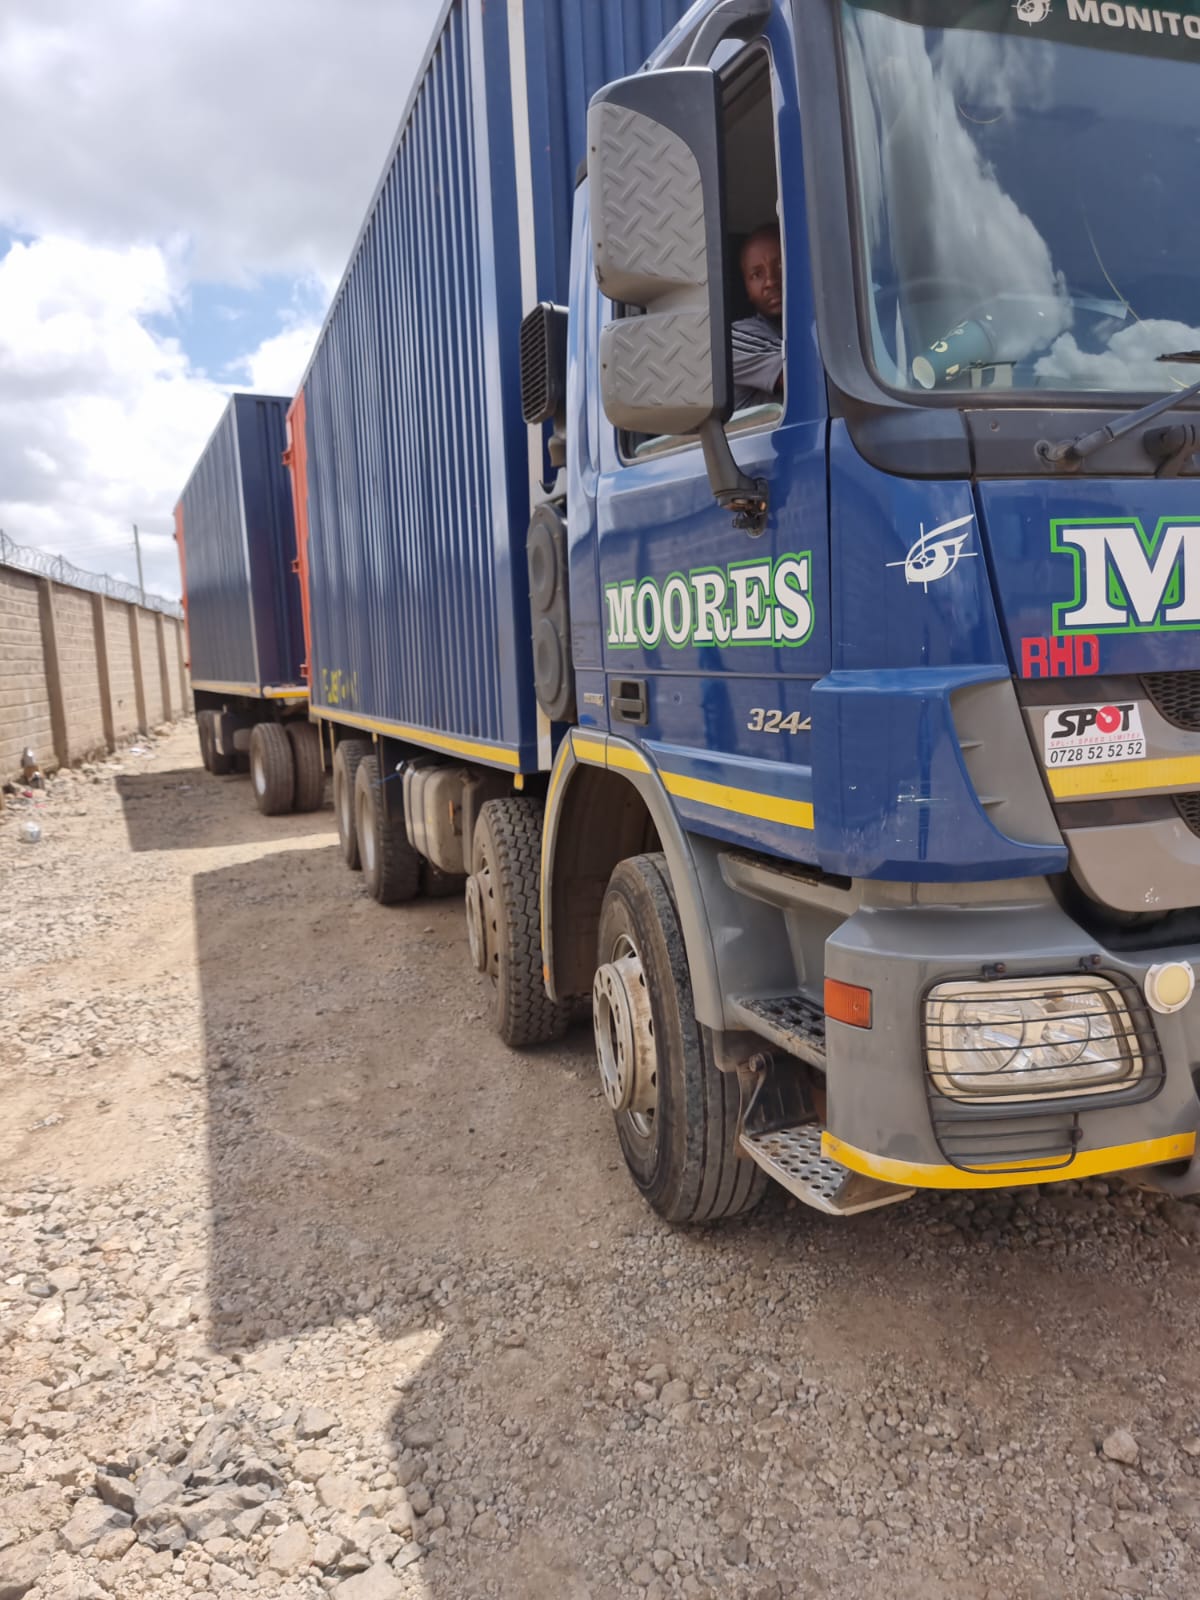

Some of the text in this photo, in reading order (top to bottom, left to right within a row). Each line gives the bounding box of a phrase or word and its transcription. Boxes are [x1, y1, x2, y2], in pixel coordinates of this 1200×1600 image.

[1067, 0, 1200, 40] MONITO
[1053, 518, 1200, 632] M
[605, 552, 813, 648] MOORES
[1021, 634, 1099, 679] RHD
[1051, 704, 1134, 738] SPOT
[1050, 742, 1143, 763] 0728 52 52 52
